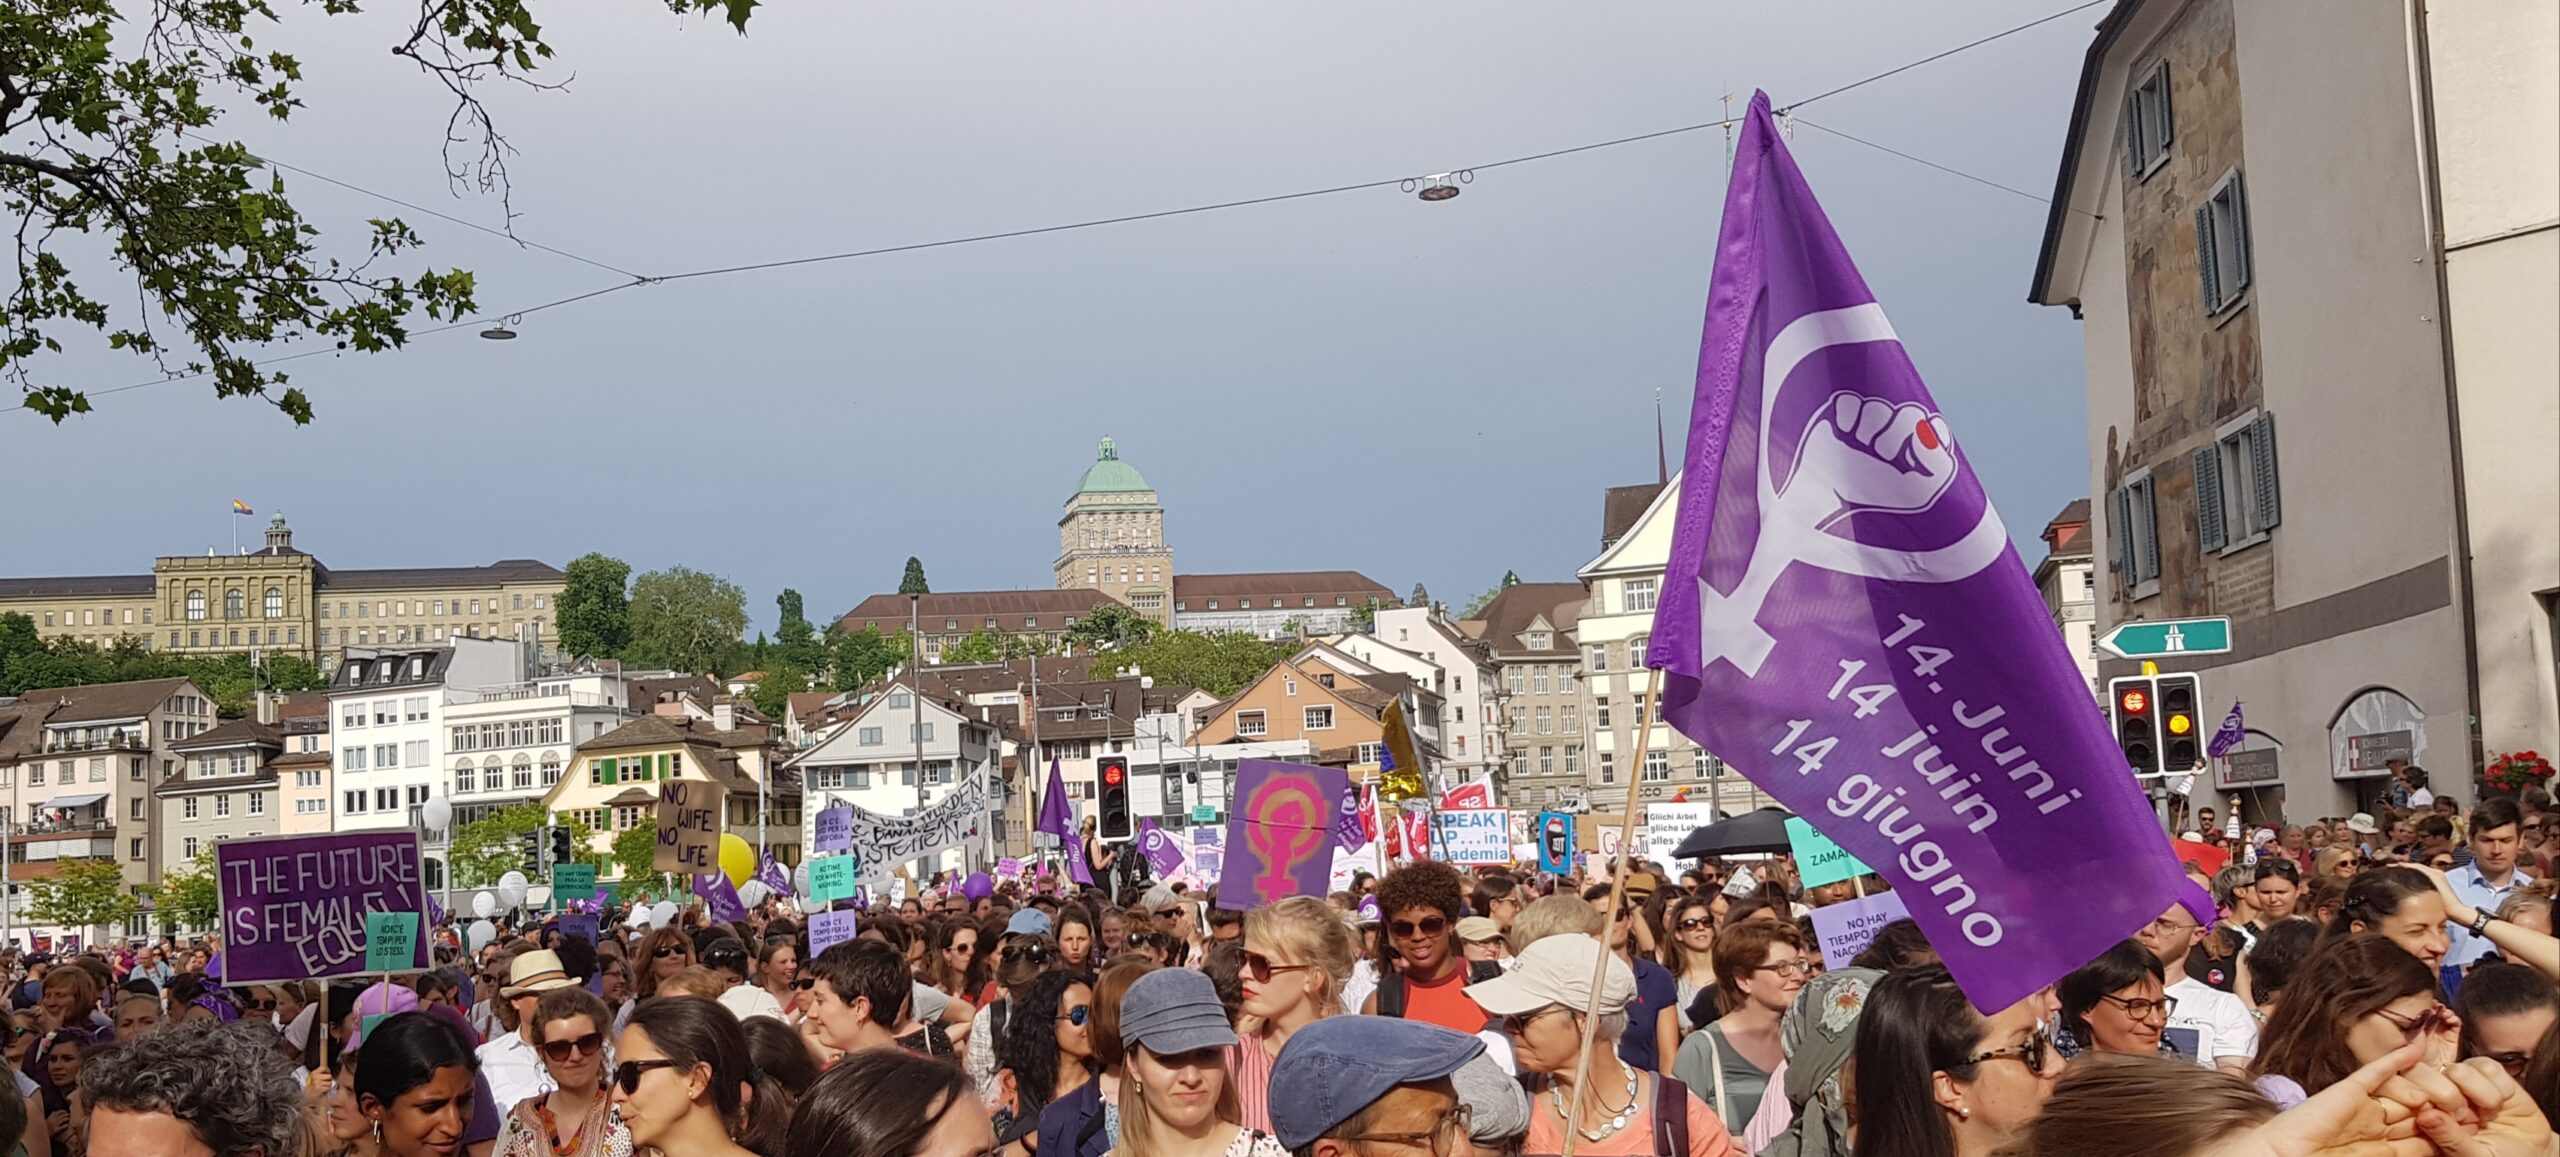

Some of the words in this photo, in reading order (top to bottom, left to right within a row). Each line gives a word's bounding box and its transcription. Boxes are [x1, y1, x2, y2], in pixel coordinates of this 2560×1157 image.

[1883, 613, 1954, 694] 14.
[1952, 699, 2083, 815] Juni
[1827, 659, 1897, 719] 14
[1881, 724, 1998, 834] juin
[662, 782, 687, 806] NO
[677, 807, 713, 832] WIFE
[1430, 812, 1496, 828] SPEAK
[658, 827, 678, 846] NO
[1484, 831, 1498, 844] in
[1651, 836, 1674, 845] alles
[1770, 719, 1839, 776] 14
[1826, 774, 2003, 947] giugno
[677, 843, 708, 867] LIFE
[225, 856, 290, 897] THE
[297, 843, 417, 891] FUTURE
[227, 906, 260, 946] IS
[1847, 920, 1864, 930] NO
[1866, 912, 1887, 926] HAY
[1828, 930, 1870, 947] TIEMPO
